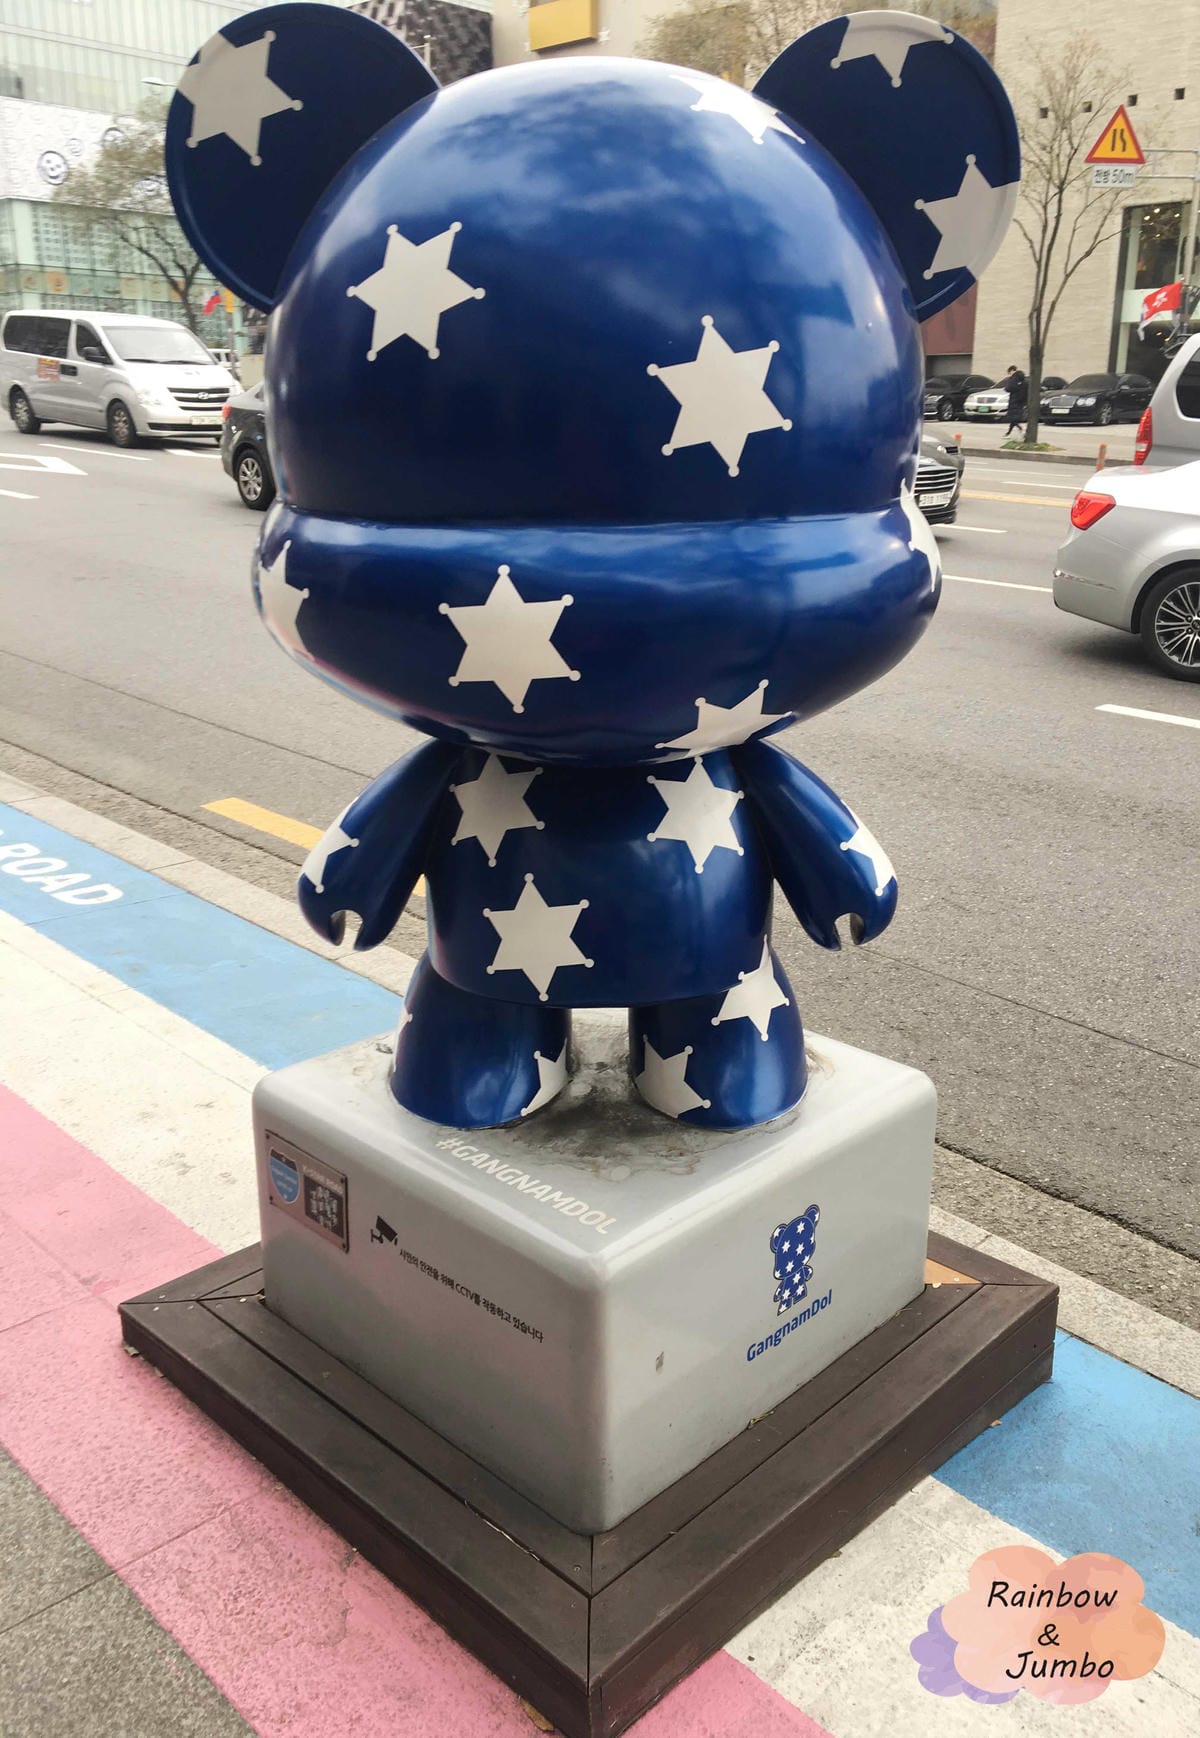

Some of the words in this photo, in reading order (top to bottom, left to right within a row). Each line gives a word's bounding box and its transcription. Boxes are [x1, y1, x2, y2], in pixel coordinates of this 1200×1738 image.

[1112, 168, 1135, 184] 50m
[435, 1137, 617, 1234] #GANGNAMDOL
[420, 1261, 439, 1280] 안전을
[441, 1274, 455, 1290] 위해
[456, 1284, 481, 1306] CCTV를
[482, 1298, 511, 1323] 작동하고
[513, 1316, 544, 1343] 있습니다
[747, 1289, 832, 1361] GangnamDol
